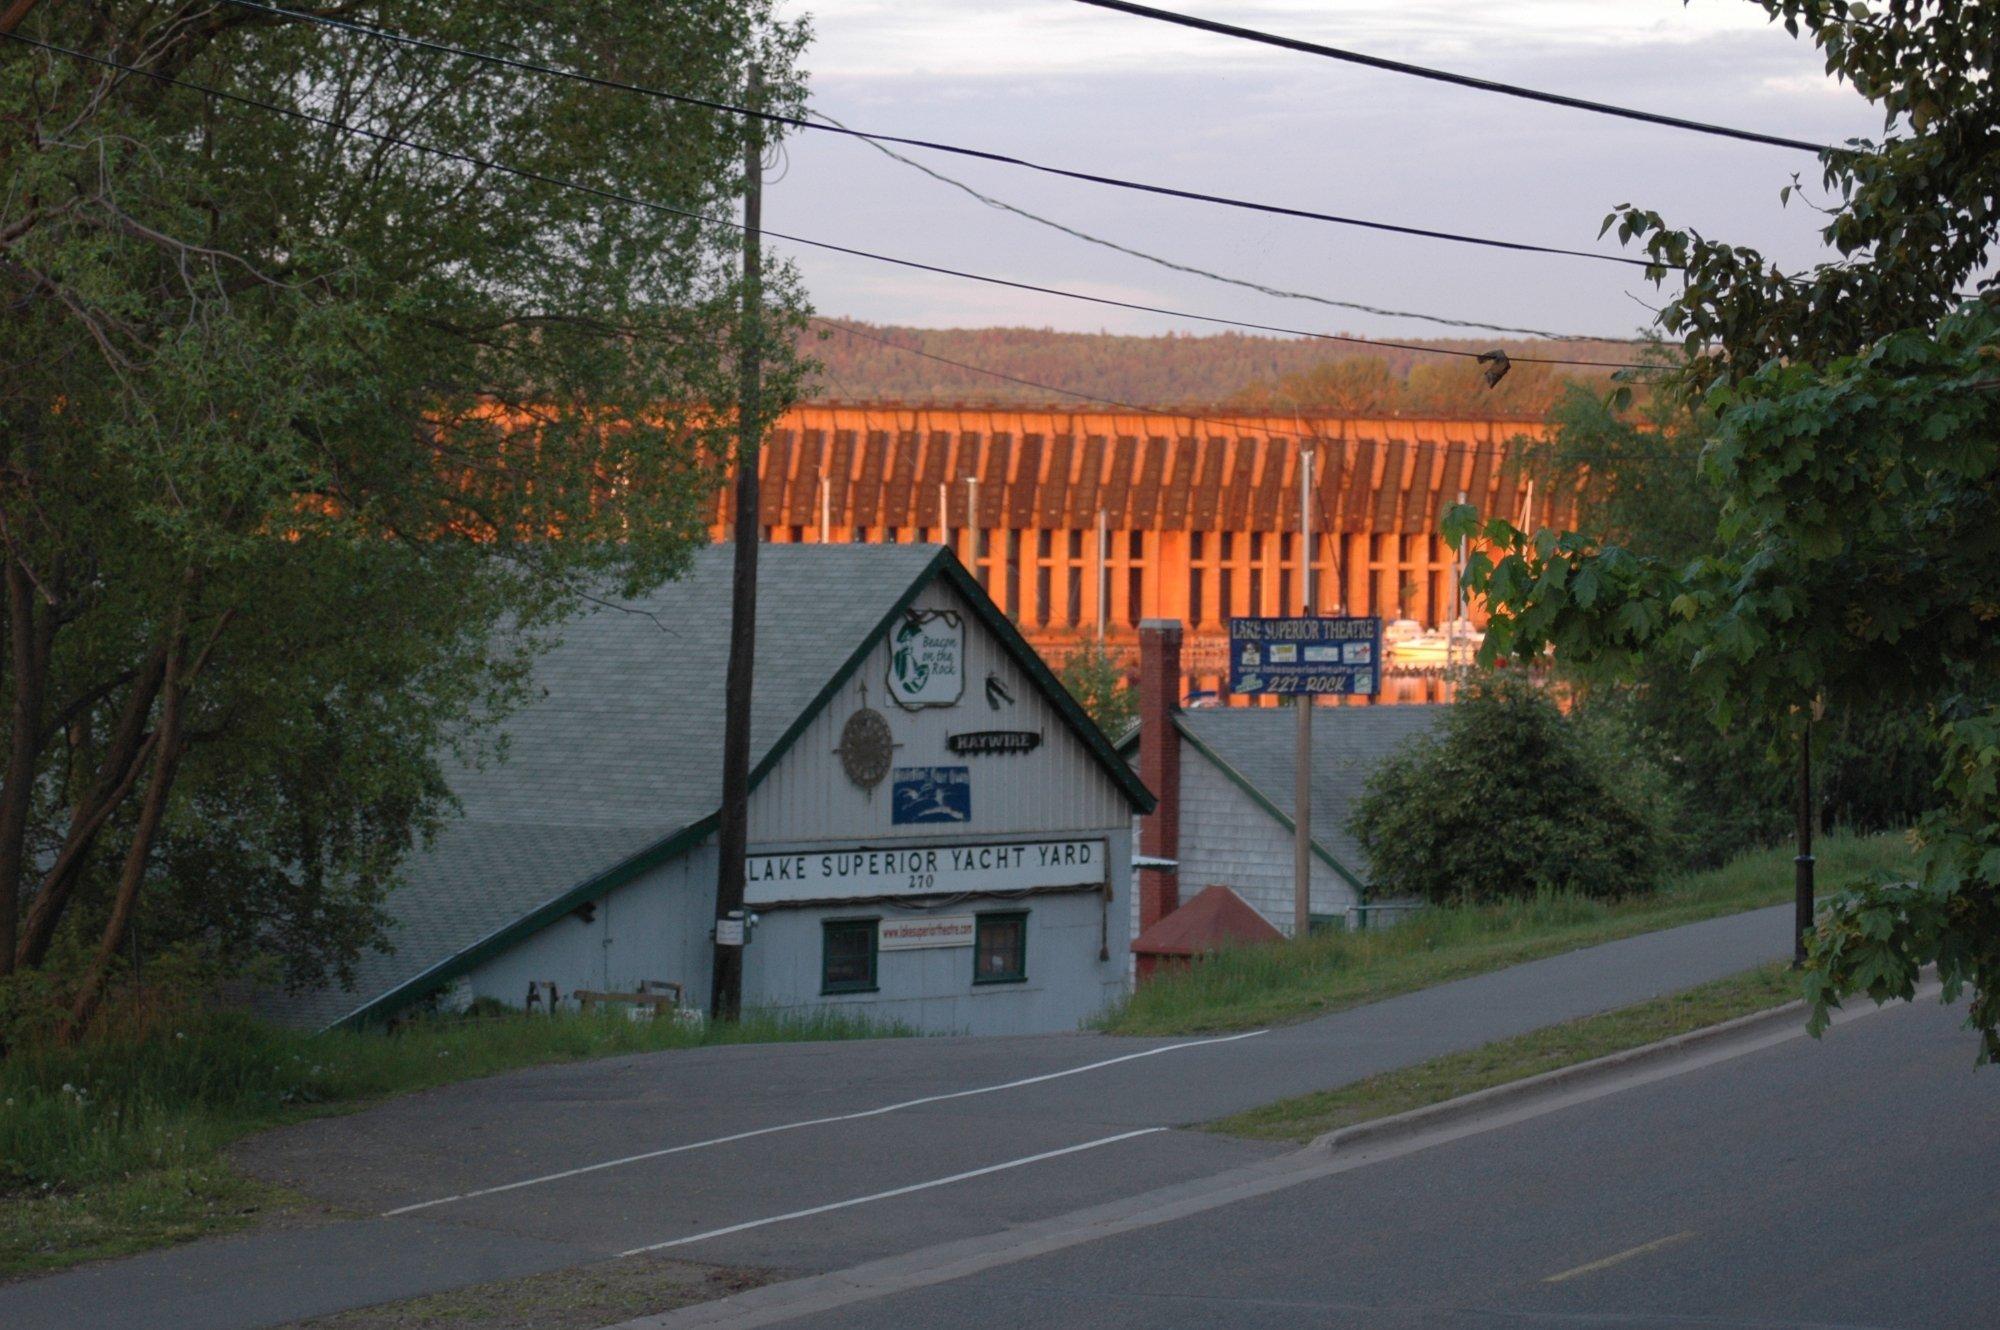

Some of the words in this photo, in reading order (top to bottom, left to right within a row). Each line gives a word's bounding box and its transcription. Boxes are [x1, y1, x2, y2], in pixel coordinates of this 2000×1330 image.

[1232, 620, 1261, 639] LAKE
[1264, 620, 1319, 639] SUPERIOR
[1323, 620, 1374, 639] THEATRE
[922, 635, 957, 648] Beacon
[922, 652, 935, 661] on
[937, 650, 953, 662] the
[931, 662, 956, 675] Rock
[958, 733, 1030, 749] HAYWIRE
[749, 857, 806, 882] LAKE
[821, 850, 938, 878] SUPERIOR
[951, 847, 1026, 872] YACHT
[1038, 844, 1091, 867] YARD
[908, 874, 934, 889] 270
